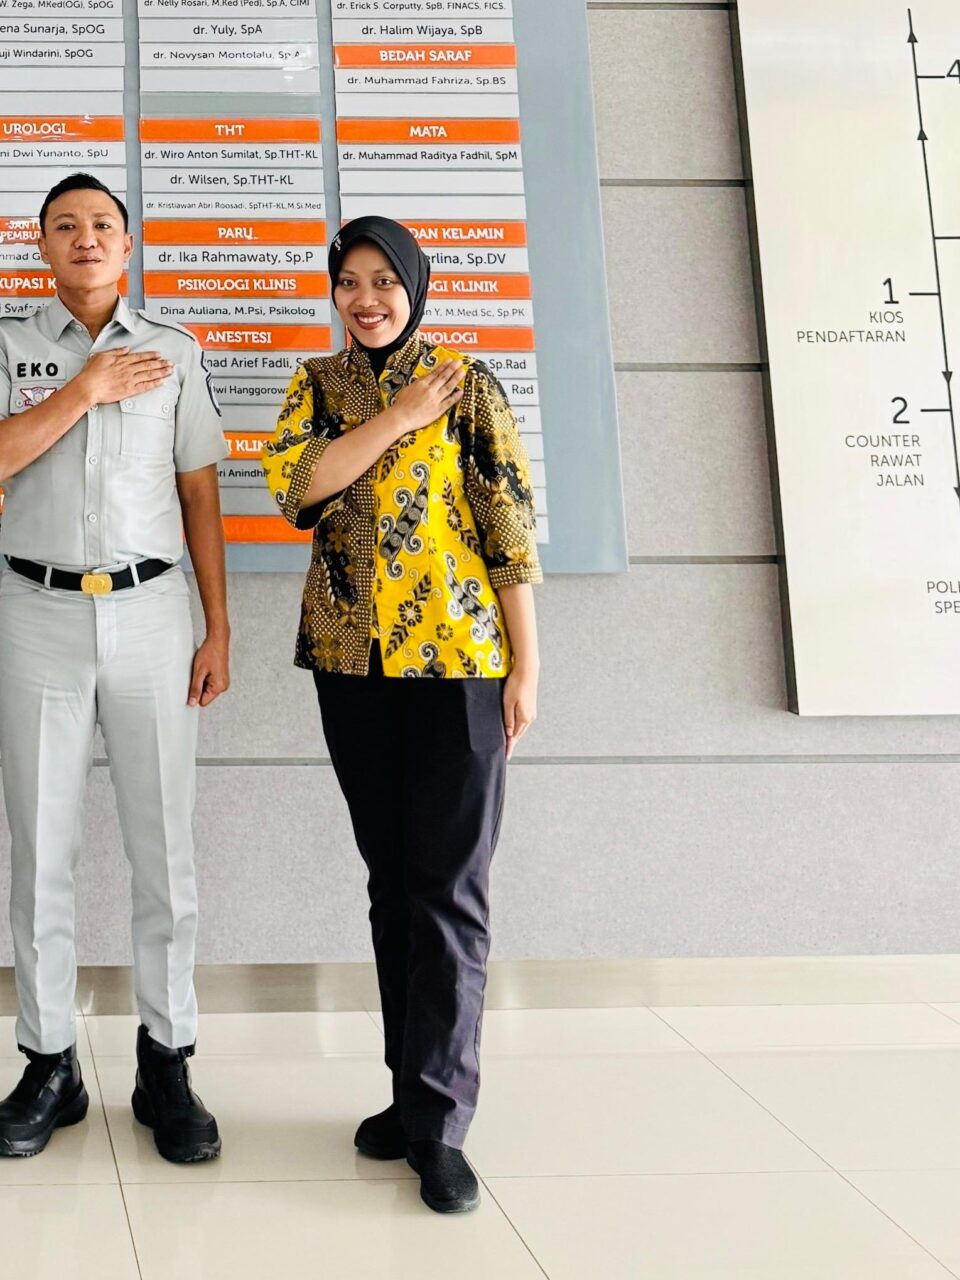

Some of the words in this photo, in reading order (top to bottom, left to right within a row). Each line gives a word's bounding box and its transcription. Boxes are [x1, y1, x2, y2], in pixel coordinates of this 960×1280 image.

[23, 23, 68, 36] Sunarja,
[71, 23, 105, 37] SpOG
[192, 24, 208, 35] dr.
[210, 24, 237, 37] Yuly,
[240, 23, 263, 37] SpA
[361, 25, 377, 35] dr.
[379, 25, 414, 35] Halim
[416, 25, 457, 38] Wijaya,
[460, 24, 483, 38] SpB
[379, 49, 425, 62] BEDAH
[429, 49, 472, 62] SARAF
[3, 122, 68, 135] UROLOGI
[214, 124, 245, 136] THT
[409, 125, 448, 138] MATA
[342, 151, 356, 161] dr.
[358, 151, 418, 161] Muhammad
[420, 150, 458, 163] Raditya
[460, 150, 493, 161] Fadhil,
[495, 150, 518, 162] SpM
[169, 174, 185, 185] dr.
[187, 174, 230, 186] Wilsen,
[233, 174, 295, 188] Sp.THT-KL
[217, 227, 253, 240] PARU
[441, 227, 504, 240] KELAMIN
[157, 251, 175, 263] dr.
[179, 251, 198, 263] Ika
[201, 250, 281, 266] Rahmawaty,
[285, 250, 314, 266] Sp.P
[177, 278, 250, 291] PSIKOLOGI
[252, 278, 297, 293] KLINIS
[451, 280, 499, 293] KLINIK
[882, 277, 900, 305] 1
[160, 305, 186, 315] Dina
[187, 305, 231, 316] Auliana,
[234, 305, 266, 317] M.Psi,
[268, 306, 316, 317] Psikolog
[869, 310, 905, 324] KIOS
[205, 330, 272, 344] ANESTESI
[796, 329, 906, 343] PENDAFTARAN
[16, 362, 59, 378] EKO
[891, 396, 911, 425] 2
[844, 434, 921, 448] COUNTER
[870, 453, 923, 467] RAWAT
[876, 473, 925, 487] JALAN
